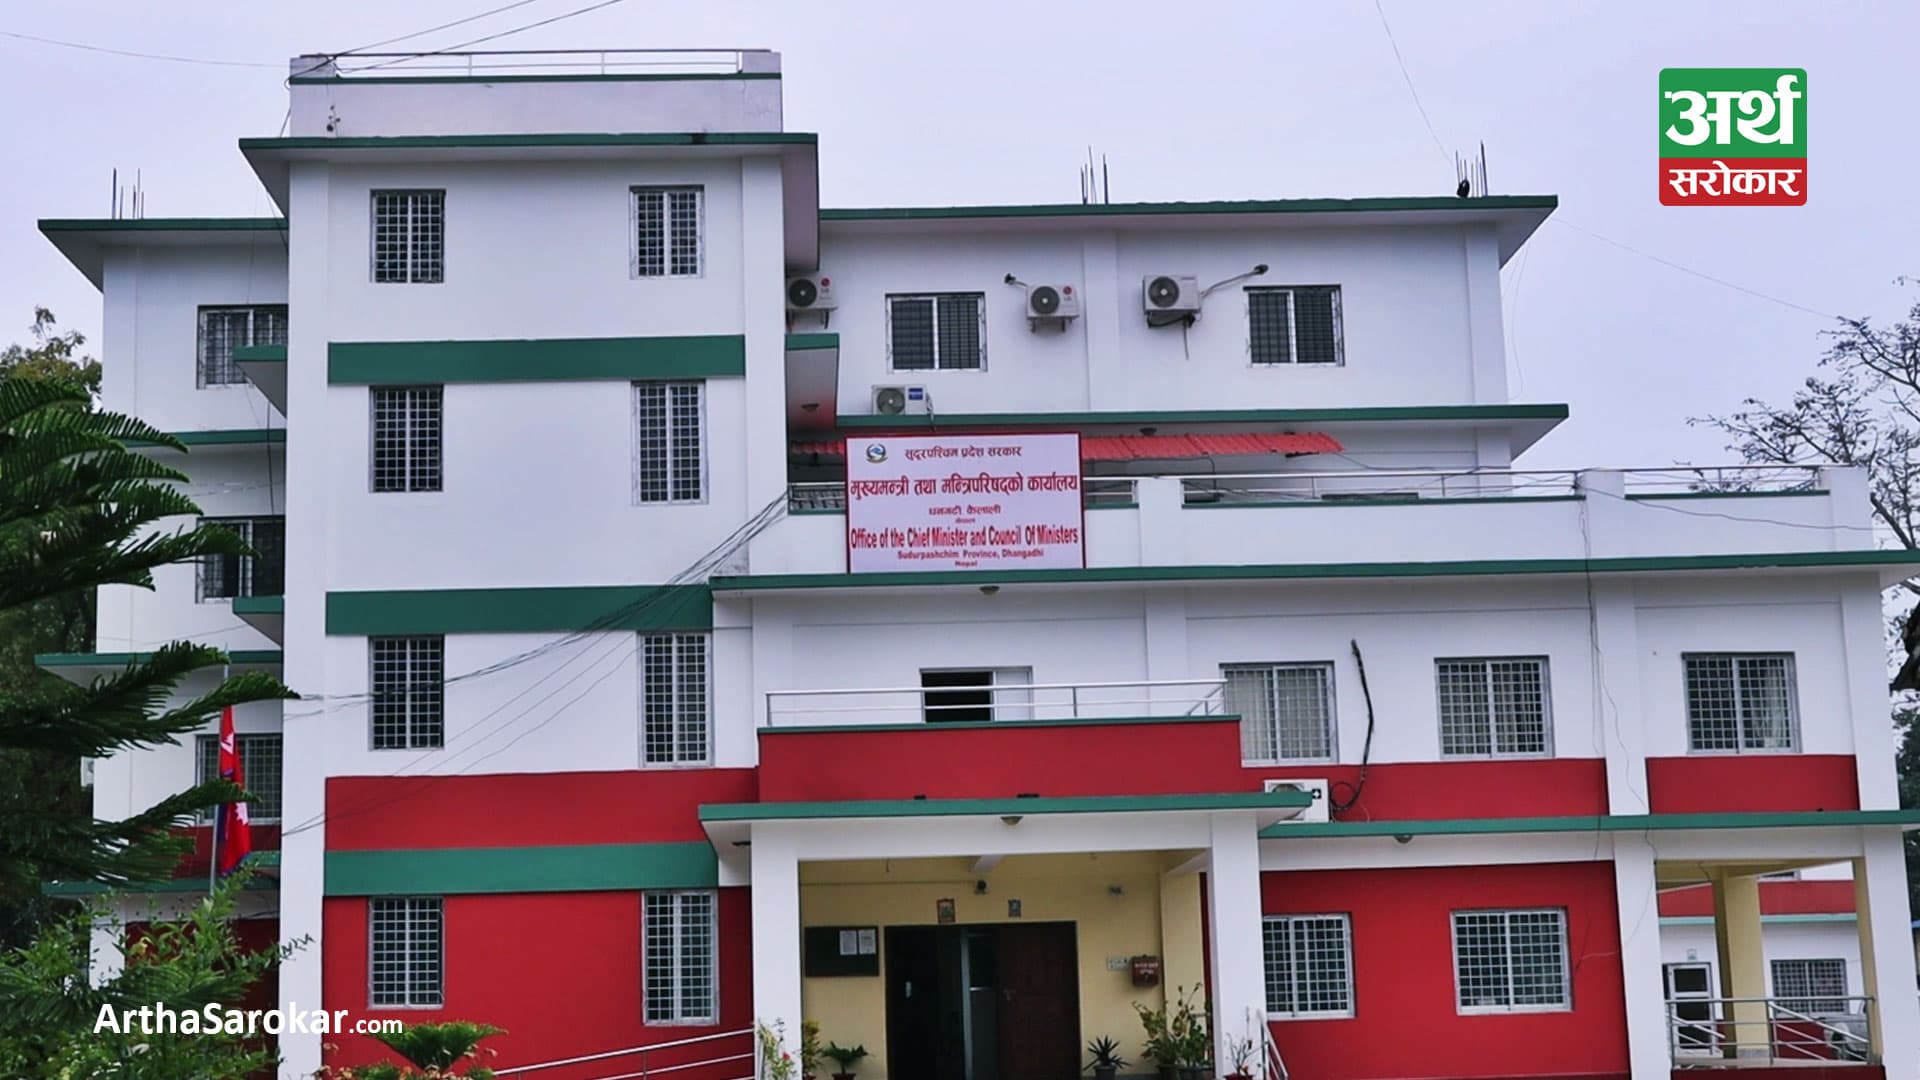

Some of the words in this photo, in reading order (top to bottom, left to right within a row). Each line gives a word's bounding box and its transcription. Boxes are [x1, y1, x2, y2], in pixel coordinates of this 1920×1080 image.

[961, 445, 984, 458] प्रदेश
[987, 446, 1022, 457] सरकार
[850, 475, 909, 500] मुख्यमन्त्री
[914, 479, 937, 496] तथा
[1027, 472, 1078, 492] कार्यालय
[851, 527, 877, 549] Office
[880, 527, 888, 548] of
[890, 527, 905, 548] the
[907, 527, 930, 547] Chief
[932, 526, 968, 547] Minister
[970, 526, 986, 546] and
[988, 525, 1021, 546] Council
[1025, 525, 1035, 546] Of
[1037, 524, 1078, 545] Ministers
[1002, 548, 1044, 560] Dhangadhi
